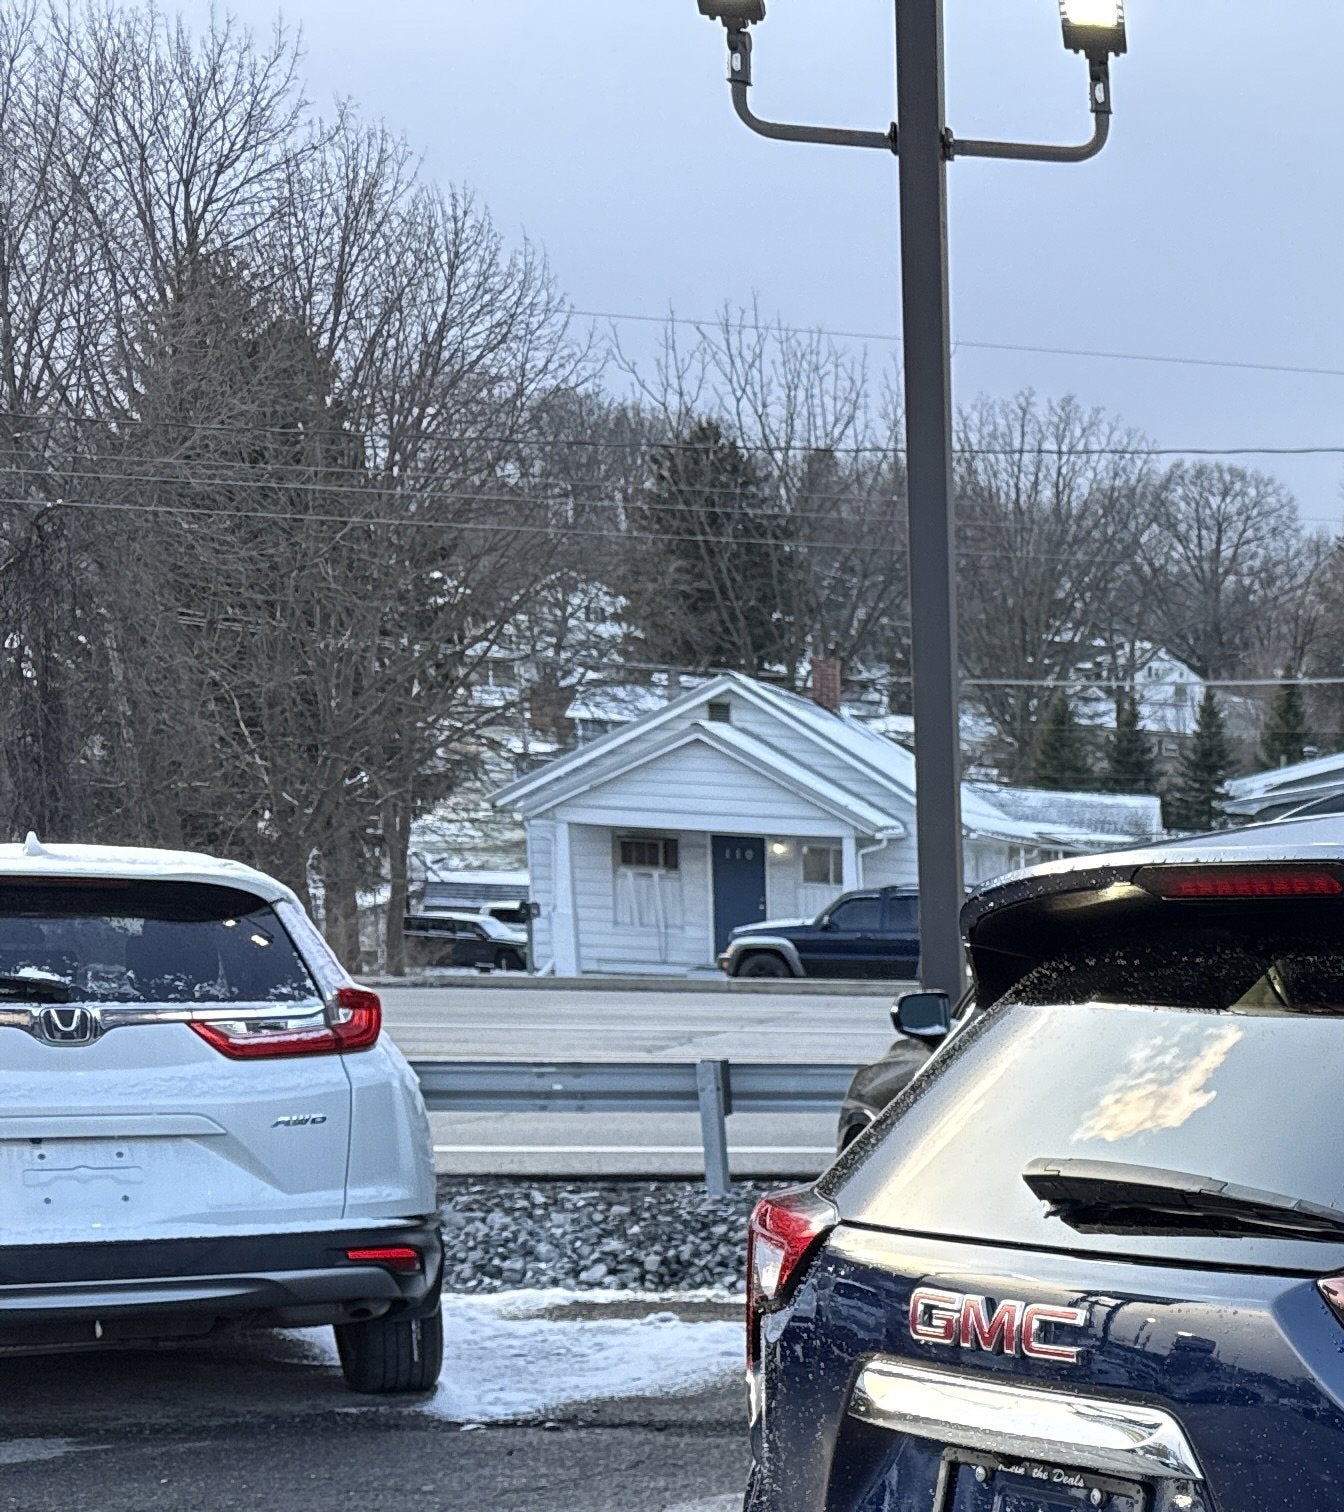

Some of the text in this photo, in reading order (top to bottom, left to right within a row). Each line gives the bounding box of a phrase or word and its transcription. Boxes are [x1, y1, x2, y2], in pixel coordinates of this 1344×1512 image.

[271, 1113, 327, 1128] AWD
[909, 1287, 1087, 1364] GMC
[1032, 1467, 1049, 1480] the
[1052, 1468, 1085, 1487] Deals
